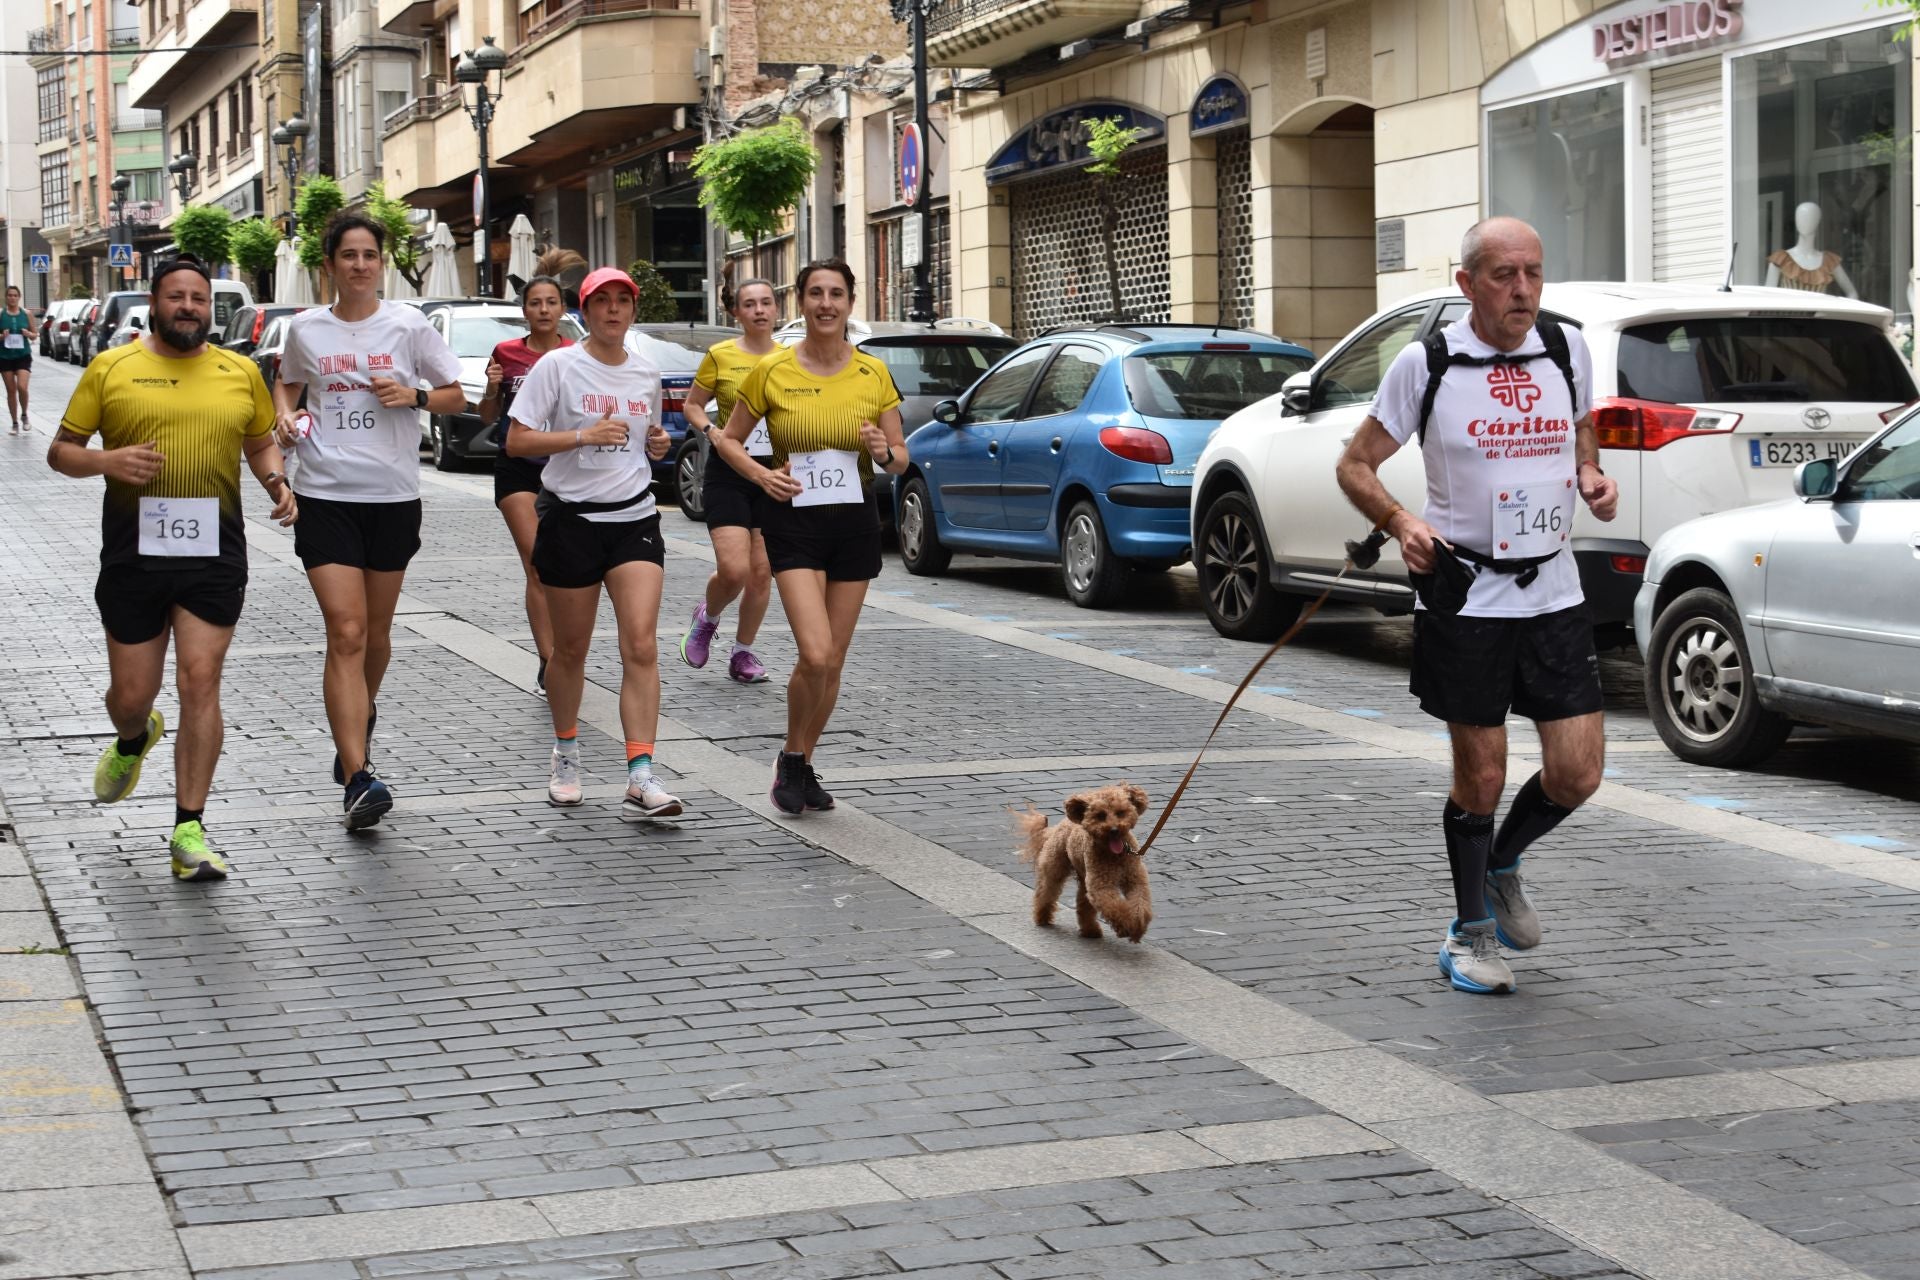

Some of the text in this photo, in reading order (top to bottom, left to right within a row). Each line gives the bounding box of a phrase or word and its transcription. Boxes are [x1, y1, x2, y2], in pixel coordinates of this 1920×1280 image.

[1593, 0, 1743, 61] DESTELLOS
[367, 353, 393, 366] berlin
[627, 399, 648, 413] berlin
[335, 410, 376, 430] 166
[1467, 416, 1569, 437] Cáritas
[1477, 433, 1567, 450] Interparroquial
[1485, 446, 1561, 460] de Calahorra
[1767, 442, 1817, 464] 6233
[806, 468, 847, 490] 162
[156, 518, 200, 539] 163
[1514, 505, 1562, 536] 146
